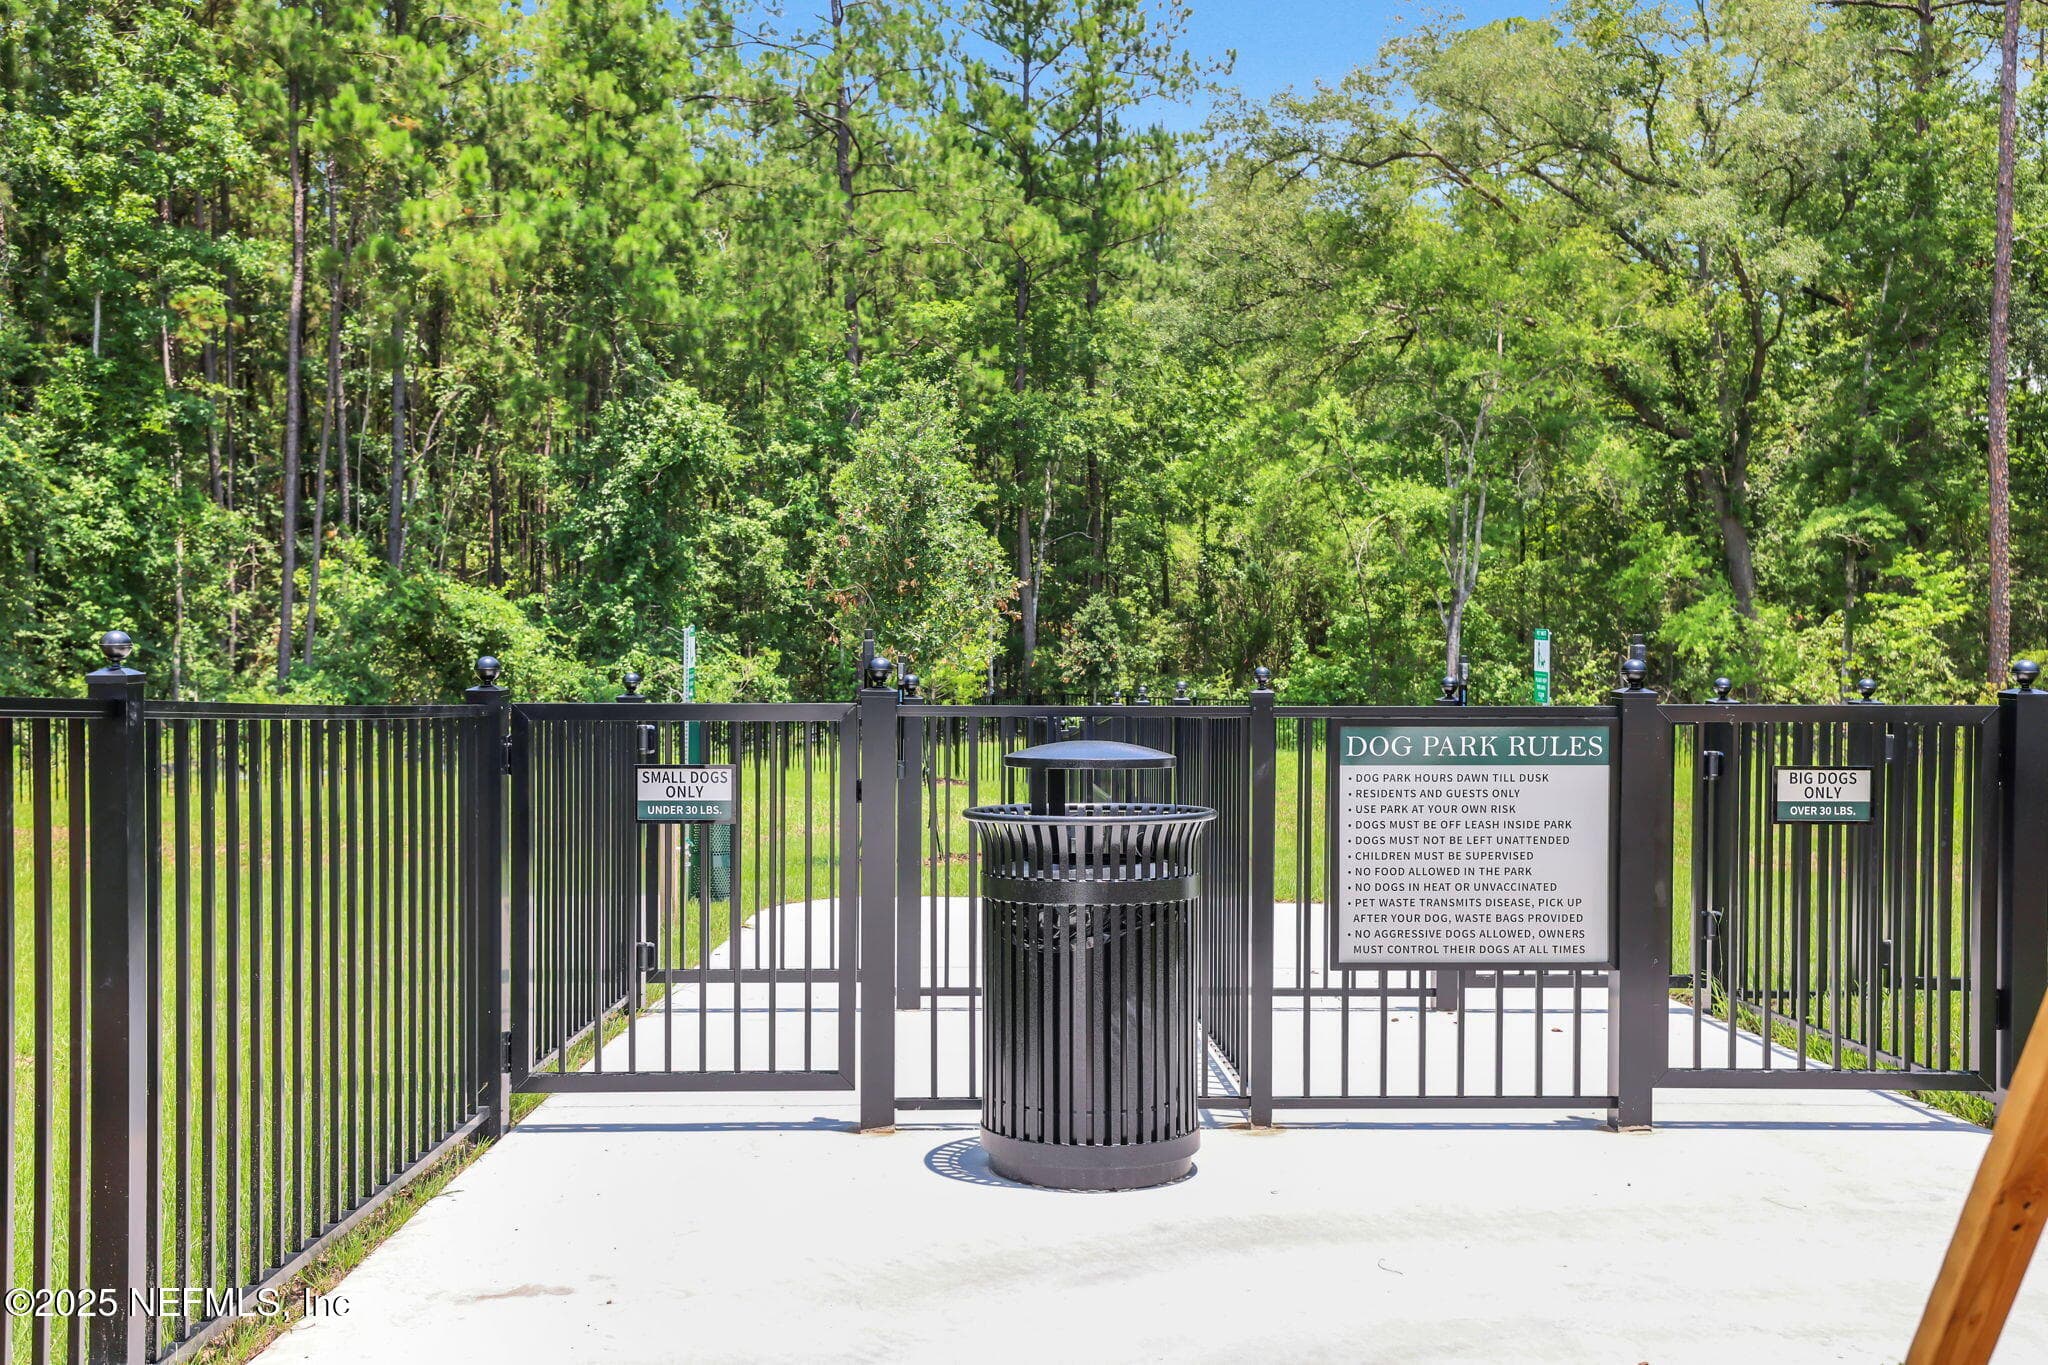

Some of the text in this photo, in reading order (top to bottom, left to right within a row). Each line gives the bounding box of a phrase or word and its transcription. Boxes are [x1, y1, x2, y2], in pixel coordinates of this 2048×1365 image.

[1346, 735, 1603, 757] DOG PARK RULES
[642, 771, 728, 784] SMALL DOGS
[1356, 773, 1549, 783] DOG PARK HOURS DAWN TILL DUSK
[1790, 772, 1857, 785] BIG DOGS
[666, 785, 704, 798] ONLY
[1355, 789, 1520, 798] RESIDENTS AND GUESTS ONLY
[1804, 786, 1842, 799] ONLY
[647, 805, 722, 815] UNDER 30 LBS.
[1356, 804, 1516, 814] USE PARK AT YOUR OWN RISK
[1790, 806, 1856, 816] OVER 30 LBS.
[1355, 820, 1572, 830] DOGS MUST BE OFF LEASH INSIDE PARK
[1355, 836, 1570, 845] DOGS MUST NOT BE LEFT UNATTENDED
[1355, 851, 1534, 861] CHILDREN MUST BE SUPERVISED
[1355, 867, 1532, 876] NO FOOD ALLOWED IN THE PARK
[1355, 882, 1557, 892] NO DOGS IN HEAT OR UNVACCINATED
[1355, 898, 1582, 908] PET WASTE TRANSMITS DISEASE, PICK UP
[1353, 913, 1584, 924] AFTER YOUR DOG, WASTE BAGS PROVIDED
[1355, 929, 1585, 940] NO AGGRESSIVE DOGS ALLOWED, OWNERS
[1353, 944, 1586, 954] MUST CONTROL THEIR DOGS AT ALL TIMES
